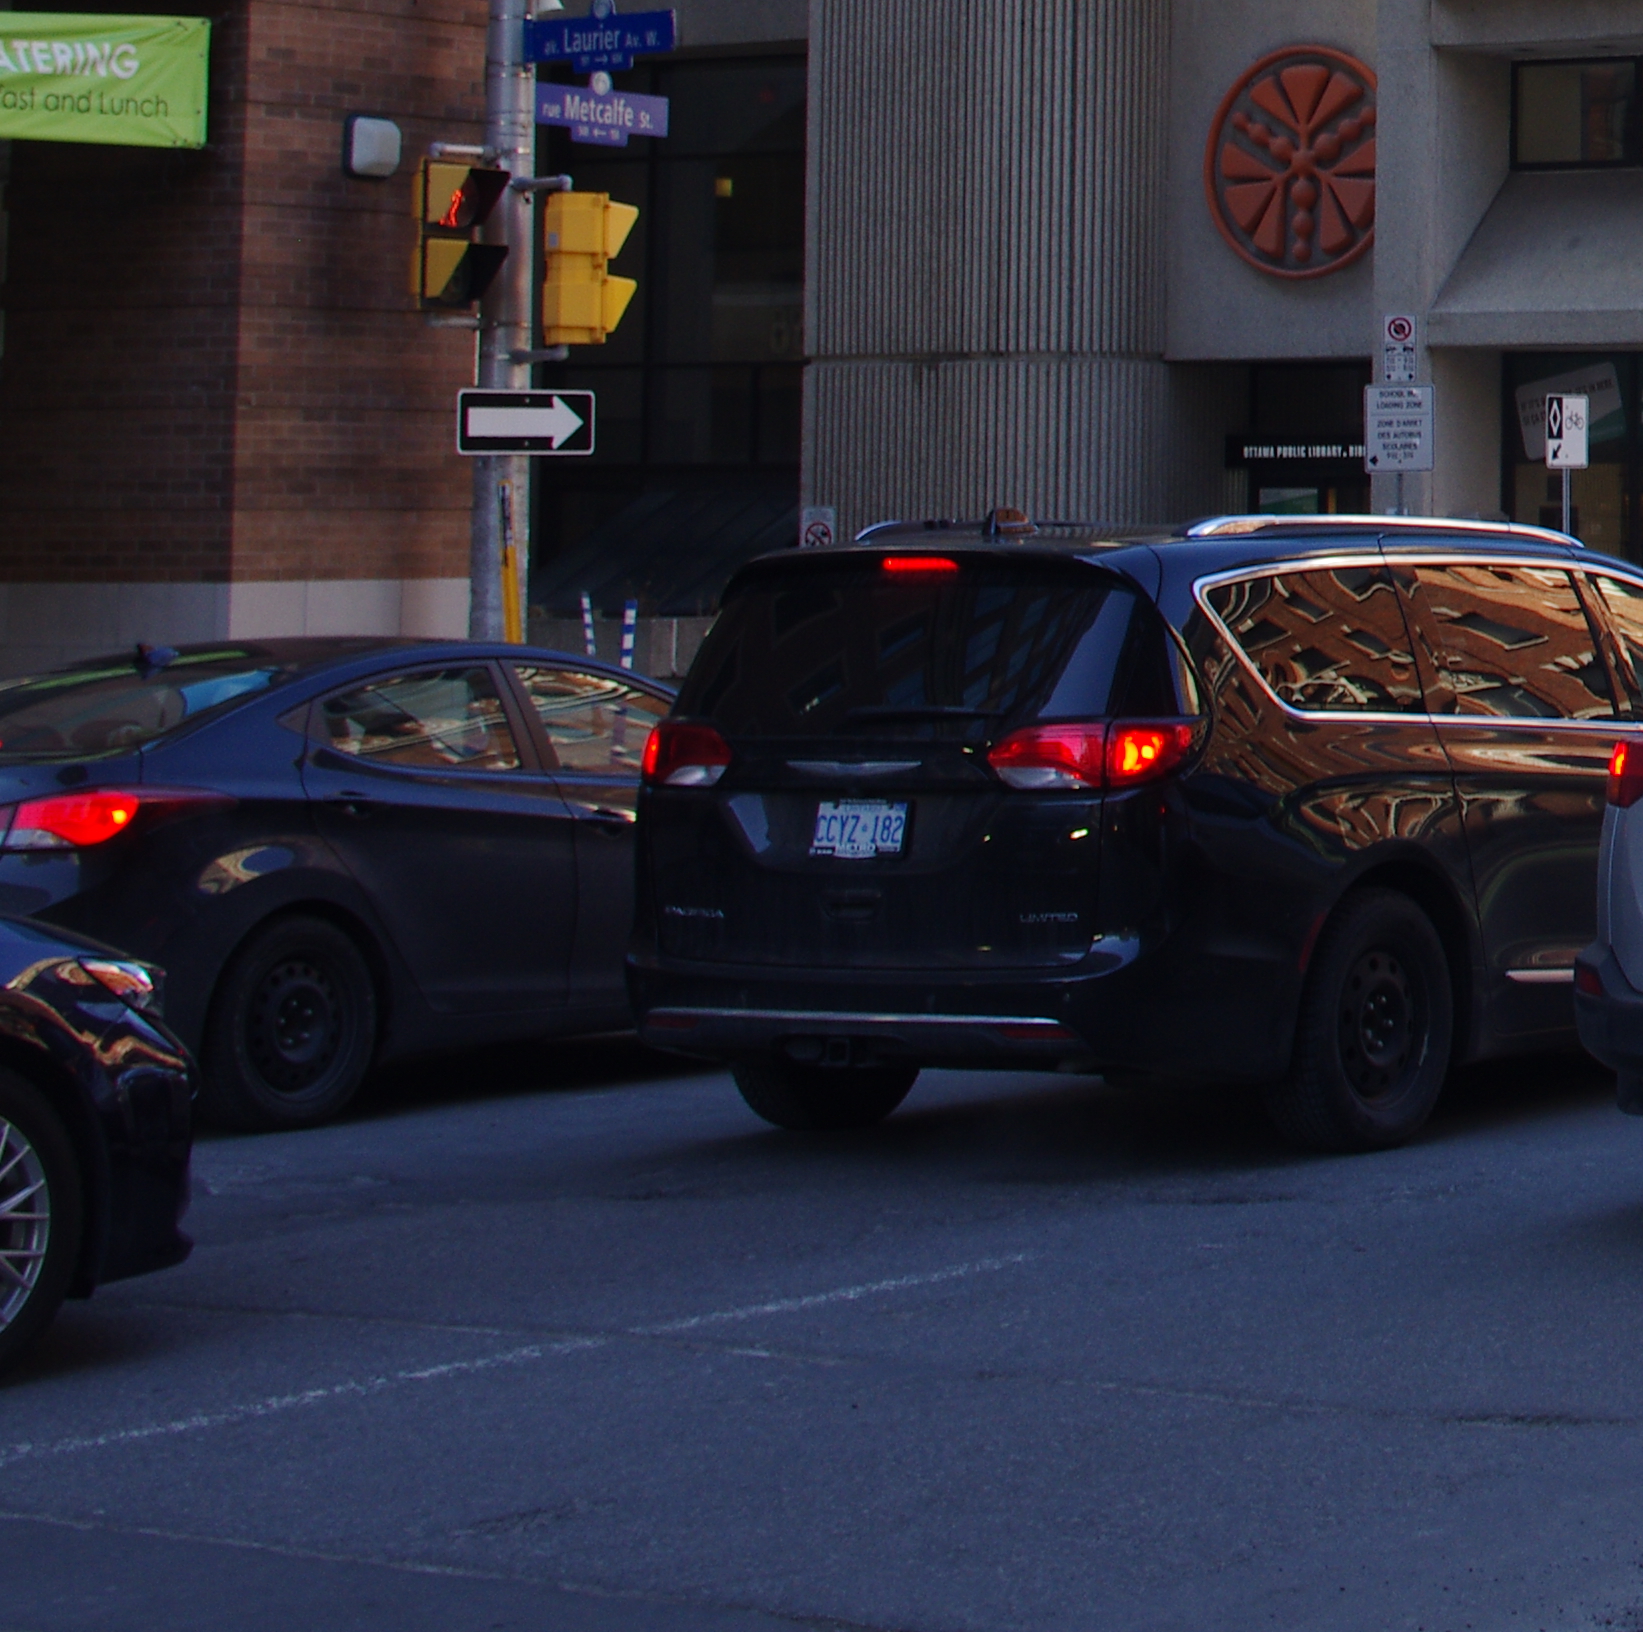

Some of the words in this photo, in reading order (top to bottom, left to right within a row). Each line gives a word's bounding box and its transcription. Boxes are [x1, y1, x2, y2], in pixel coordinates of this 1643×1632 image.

[563, 24, 621, 53] Laurier
[645, 30, 661, 46] W.
[44, 87, 92, 114] and
[100, 90, 169, 118] Lunch
[542, 103, 561, 118] rue
[564, 94, 634, 127] Metcalfe
[640, 111, 654, 130] St.
[1376, 401, 1404, 410] LOADING
[1406, 401, 1422, 409] ZONE
[1243, 445, 1275, 459] OTTAWA
[1277, 445, 1306, 459] PUBLIC
[1308, 444, 1342, 458] LIBRARY
